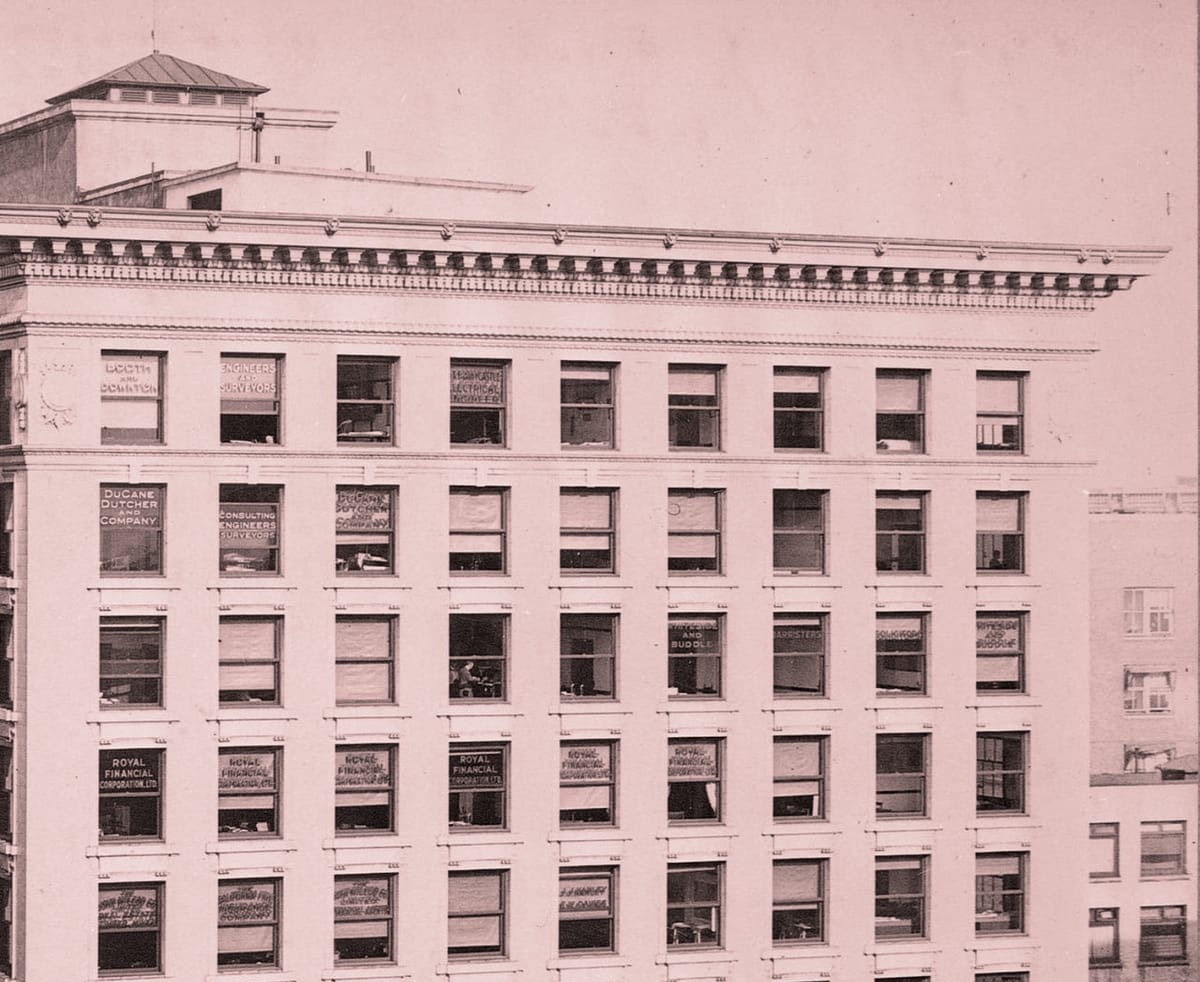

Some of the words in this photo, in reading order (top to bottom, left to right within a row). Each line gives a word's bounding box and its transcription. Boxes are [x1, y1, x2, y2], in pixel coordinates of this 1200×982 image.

[220, 363, 276, 374] ENGINEERS
[220, 383, 276, 393] SURVEYORS
[100, 500, 158, 509] DUTCHER
[219, 512, 276, 520] CONSULTING
[100, 516, 157, 526] COMPANY
[220, 522, 276, 530] ENGINEERS
[112, 758, 146, 768] ROYAL
[459, 755, 490, 764] ROYAL
[104, 769, 154, 778] FINANCIAL
[453, 765, 498, 774] FINANCIAL
